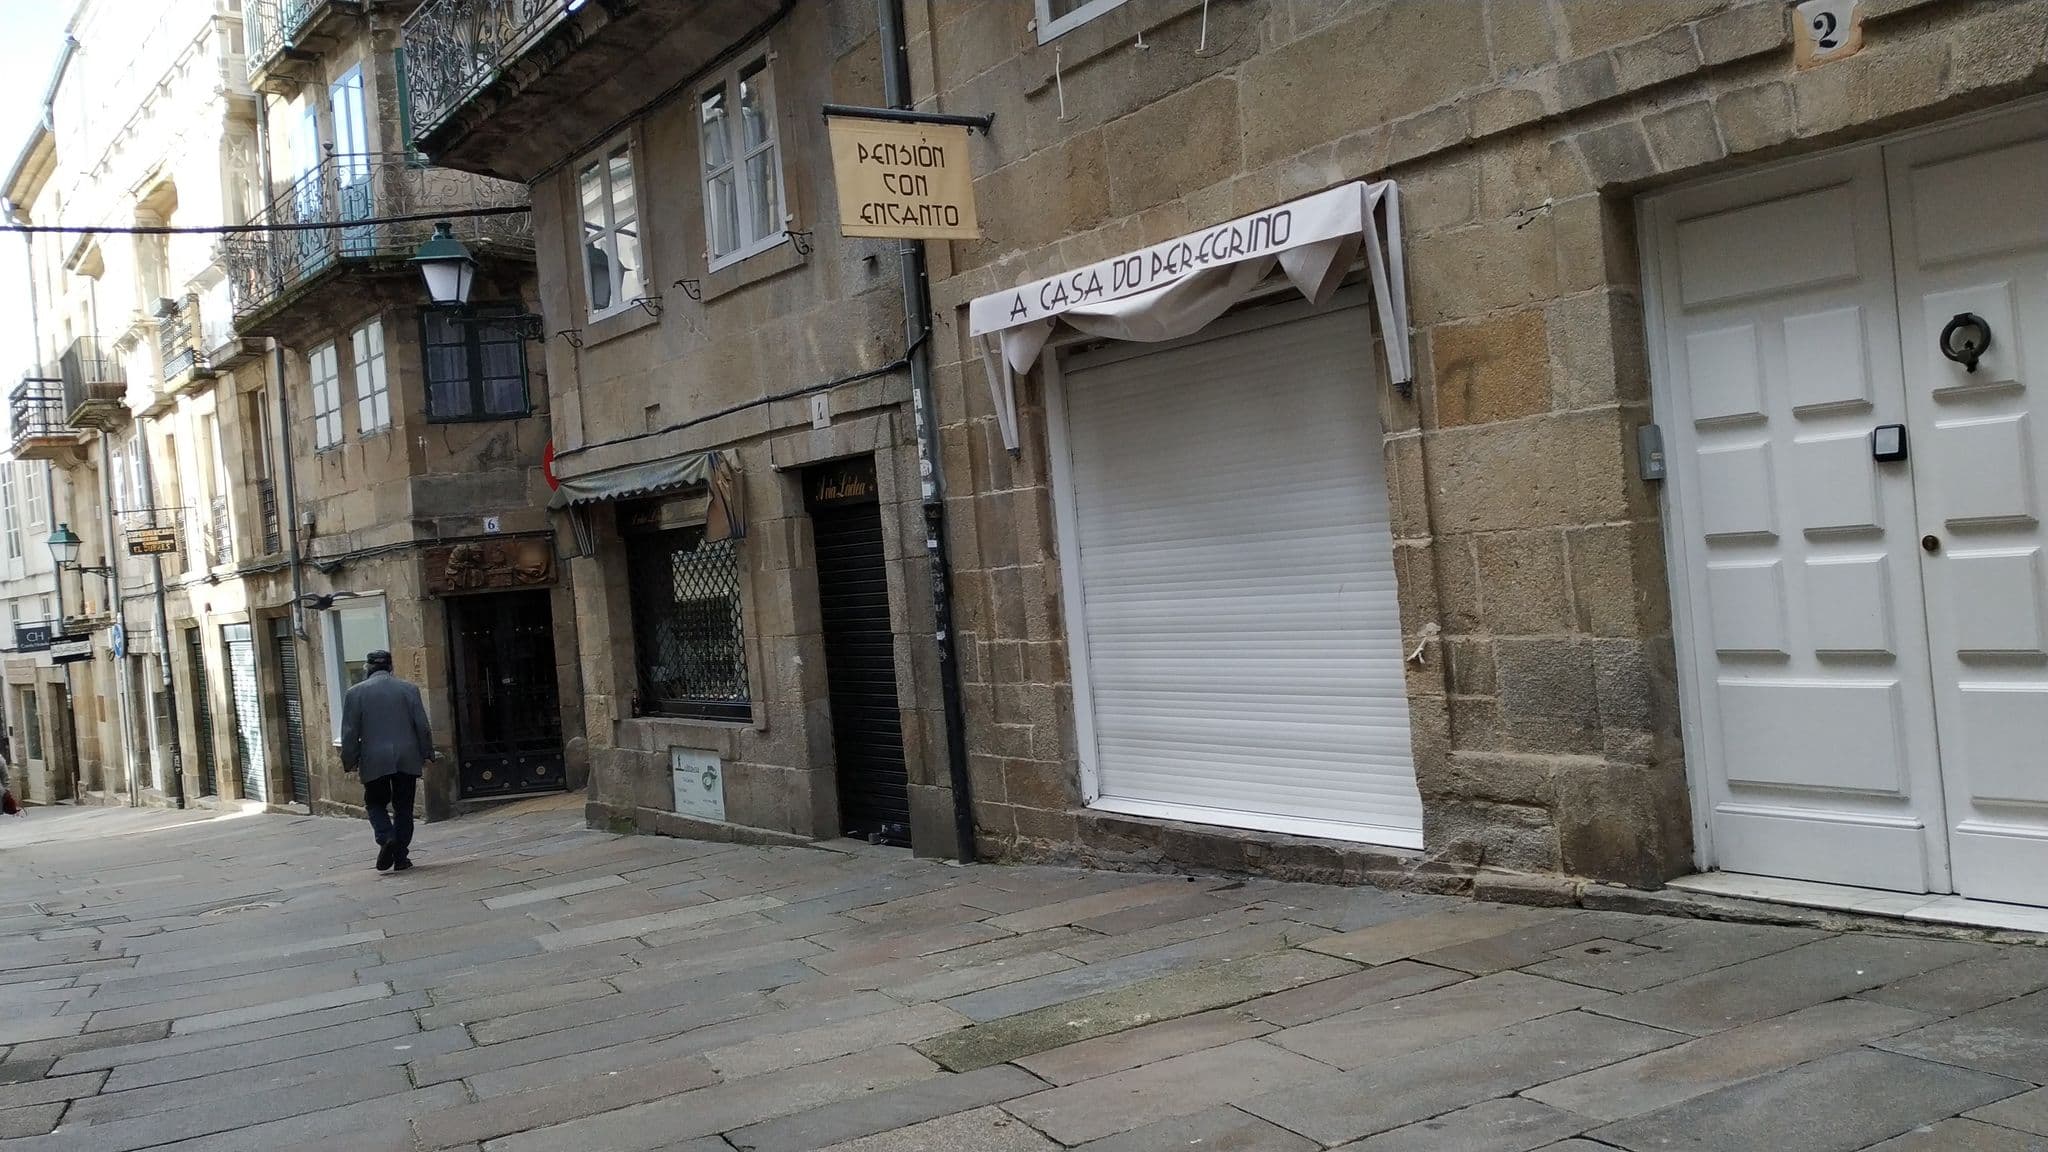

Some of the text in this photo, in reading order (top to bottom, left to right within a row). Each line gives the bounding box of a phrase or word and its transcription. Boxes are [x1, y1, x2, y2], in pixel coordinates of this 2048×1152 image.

[1813, 12, 1838, 48] 2
[857, 138, 945, 168] PENSIÓN
[882, 173, 929, 196] CON
[860, 203, 959, 226] ENCANTO
[1010, 209, 1292, 321] A CASA DO PEREGRINO
[487, 519, 496, 530] 6
[26, 631, 44, 642] CH
